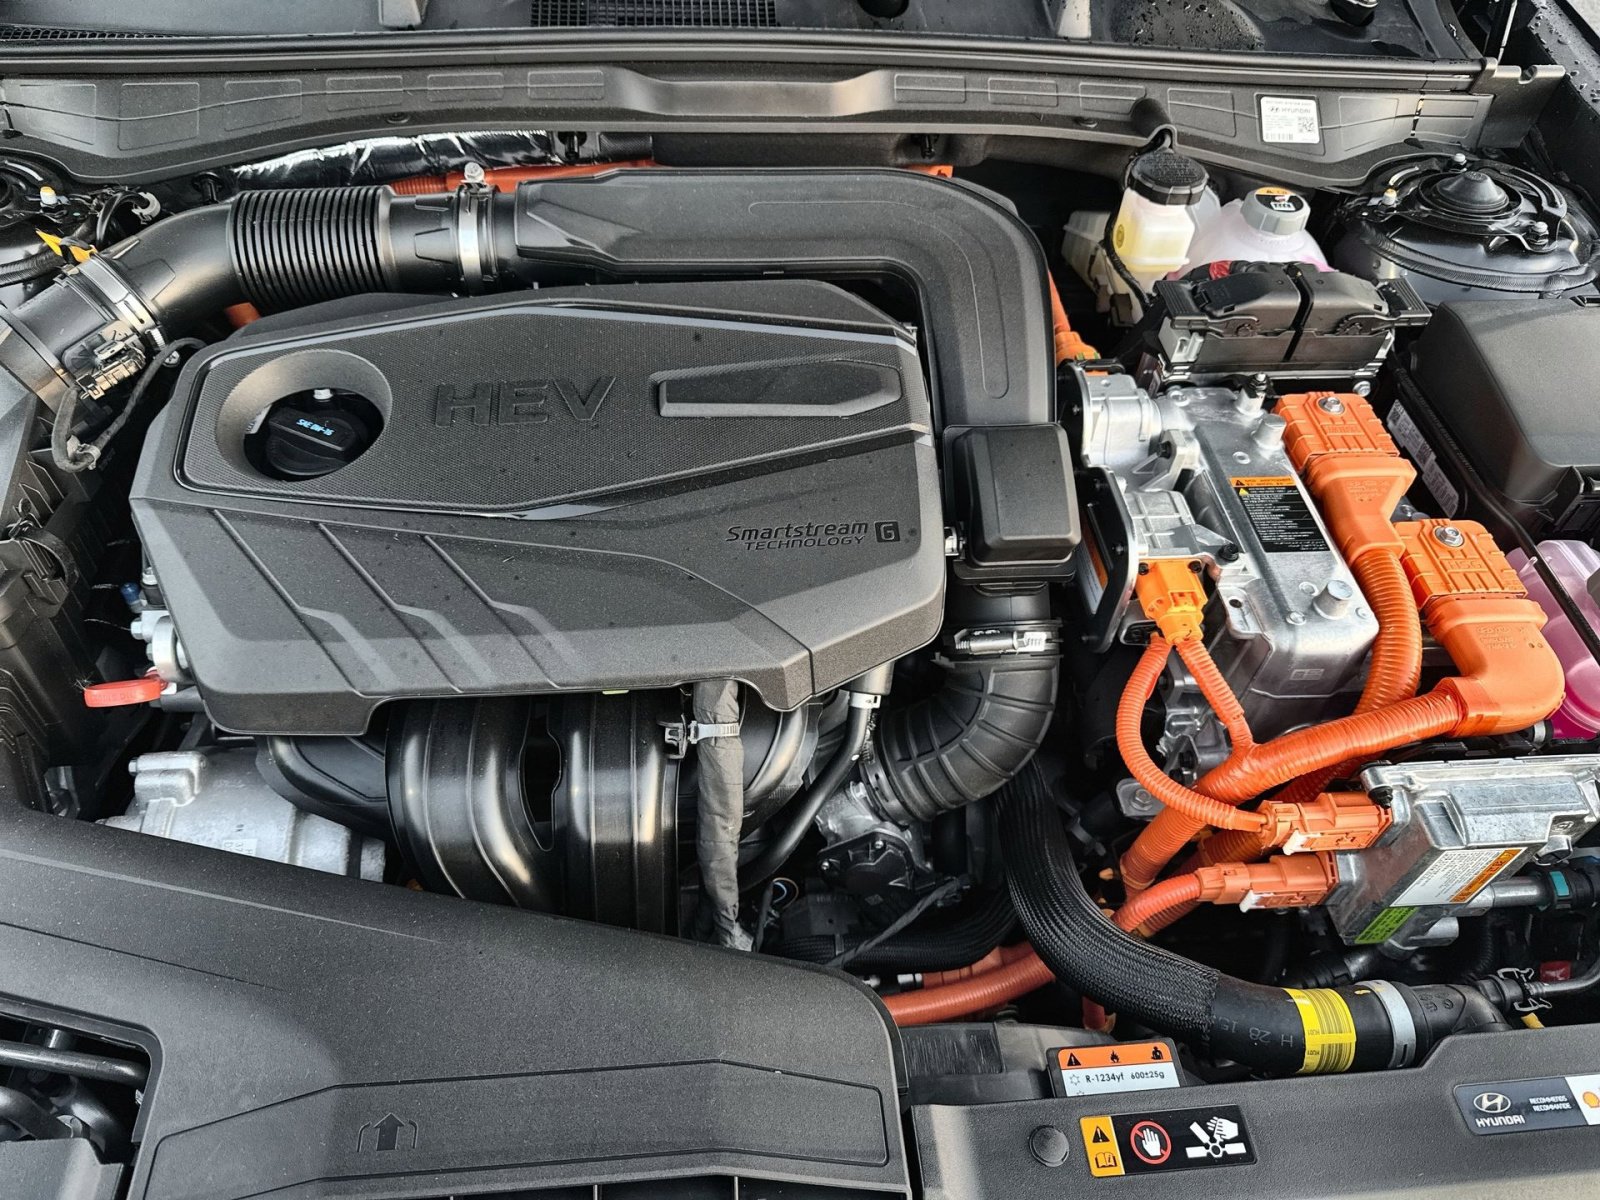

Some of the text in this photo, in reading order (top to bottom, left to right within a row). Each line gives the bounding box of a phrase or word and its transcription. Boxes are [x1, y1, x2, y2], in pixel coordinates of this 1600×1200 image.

[435, 376, 617, 428] HEV
[725, 522, 898, 542] Smartstream G
[744, 535, 866, 551] TECHNOLOGY
[1280, 1034, 1294, 1048] H
[1475, 1115, 1526, 1128] HYUNDAI
